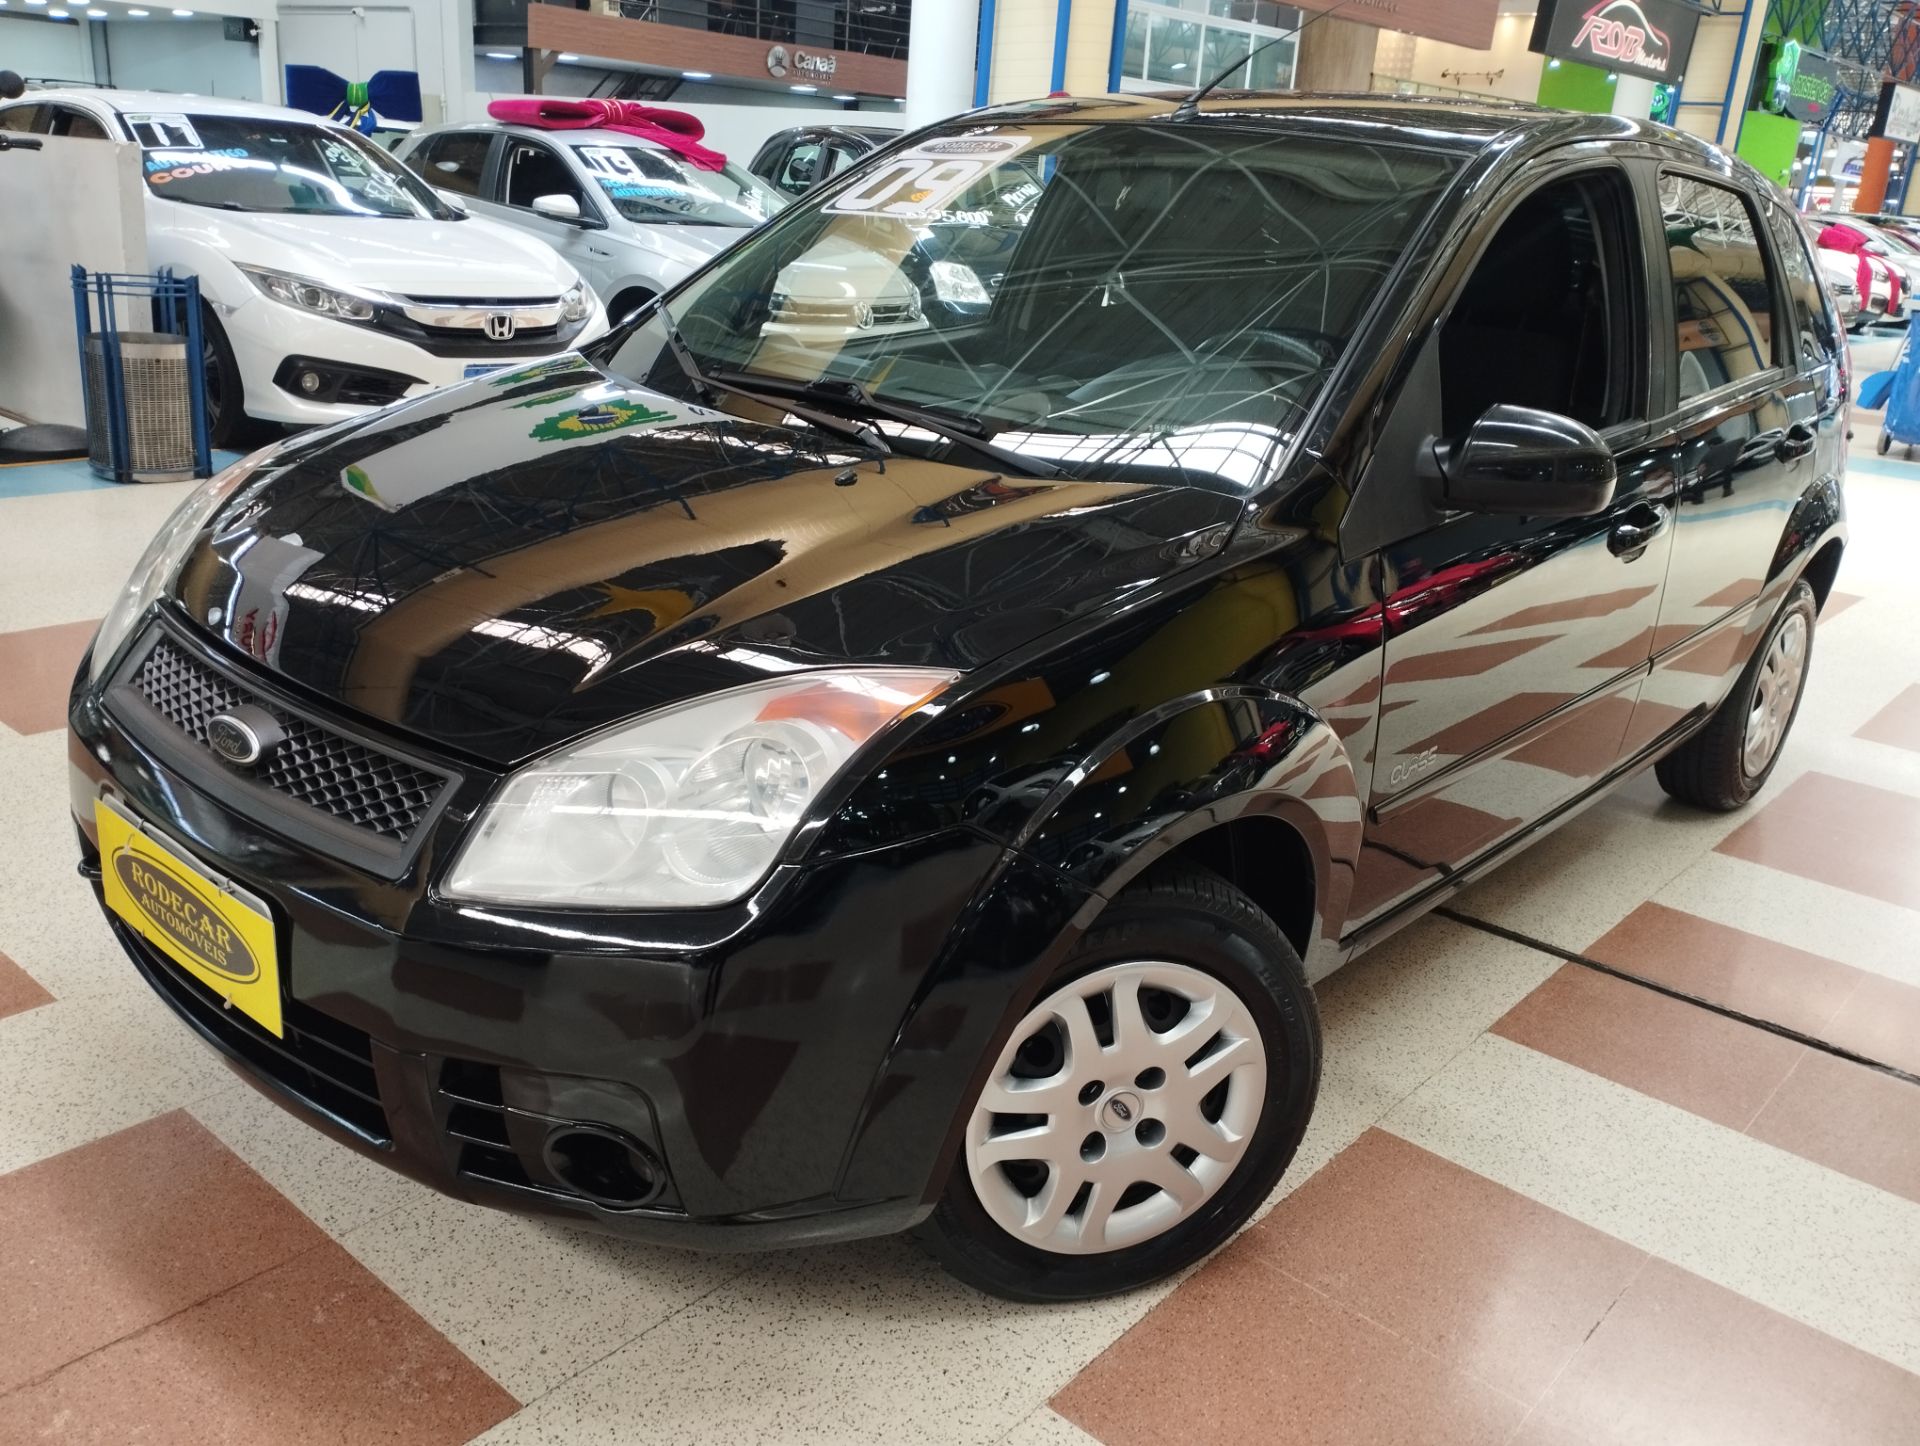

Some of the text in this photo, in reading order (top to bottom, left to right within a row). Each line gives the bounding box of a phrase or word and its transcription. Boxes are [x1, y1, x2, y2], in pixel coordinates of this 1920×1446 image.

[794, 50, 836, 73] Canaã
[834, 160, 983, 212] 09
[131, 862, 232, 953] RODECAR
